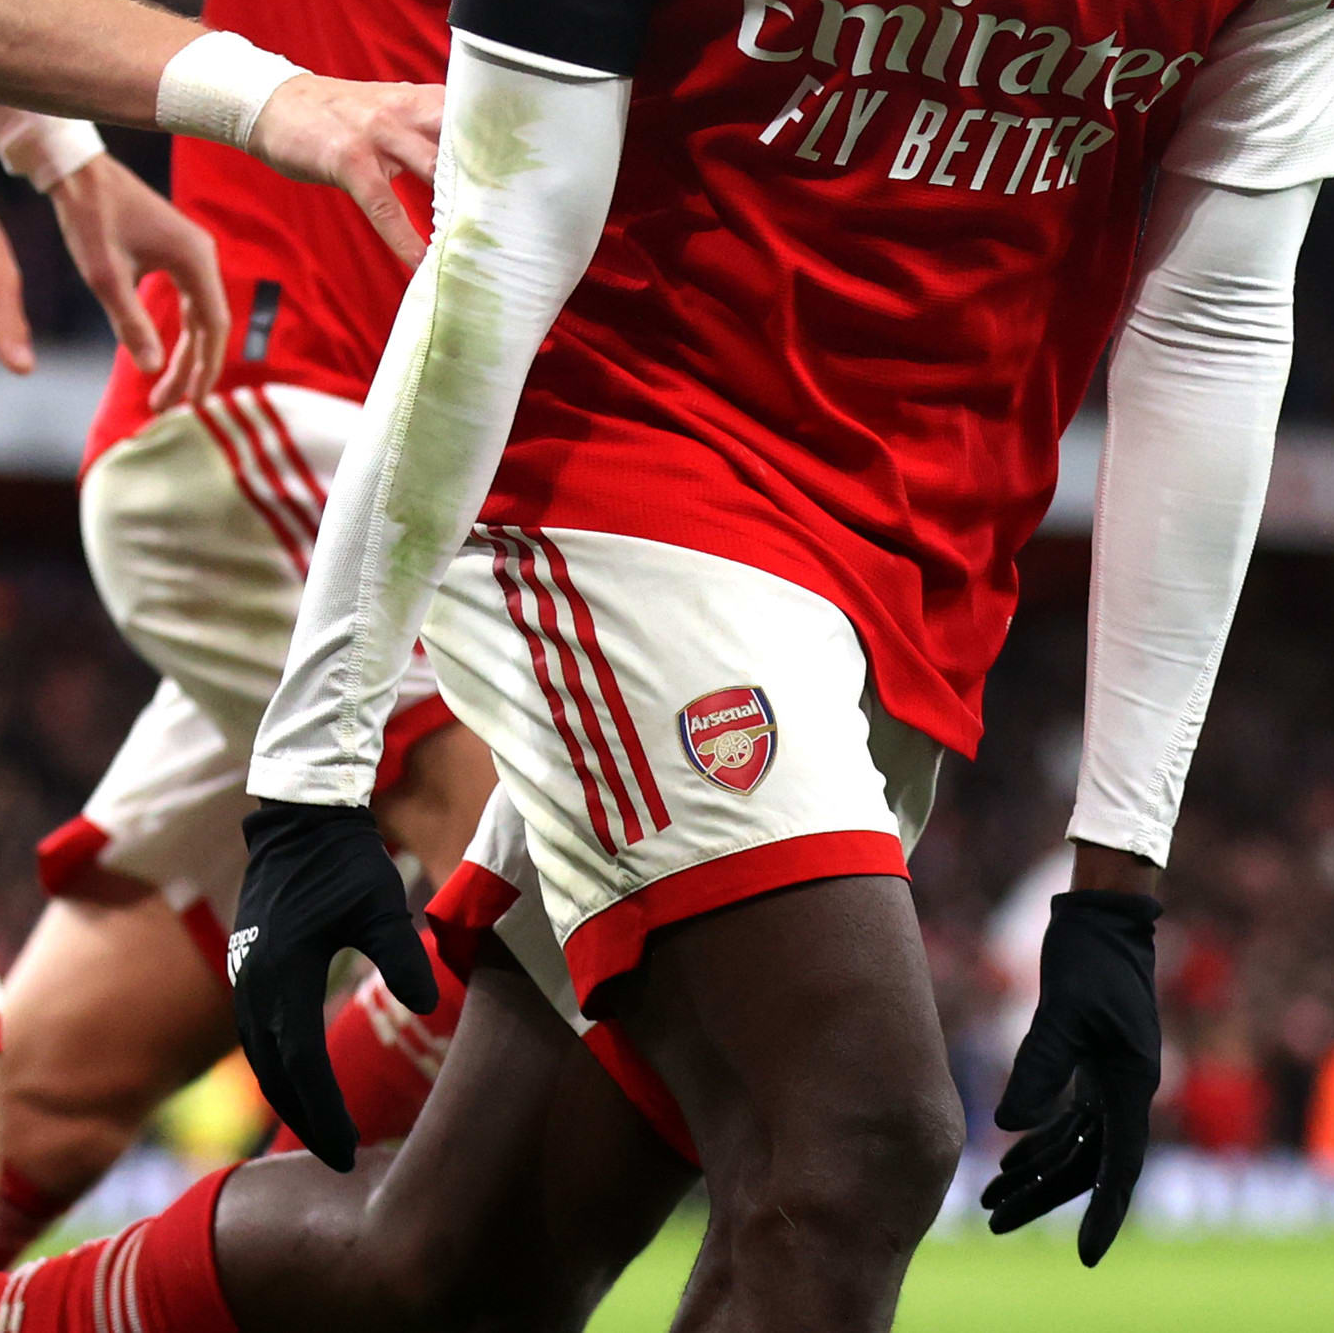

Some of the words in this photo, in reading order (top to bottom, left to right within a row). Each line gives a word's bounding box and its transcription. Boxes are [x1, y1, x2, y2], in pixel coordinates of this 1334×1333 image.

[758, 74, 889, 167] FLY
[888, 99, 1116, 196] BETTER
[690, 699, 760, 734] Arsenal
